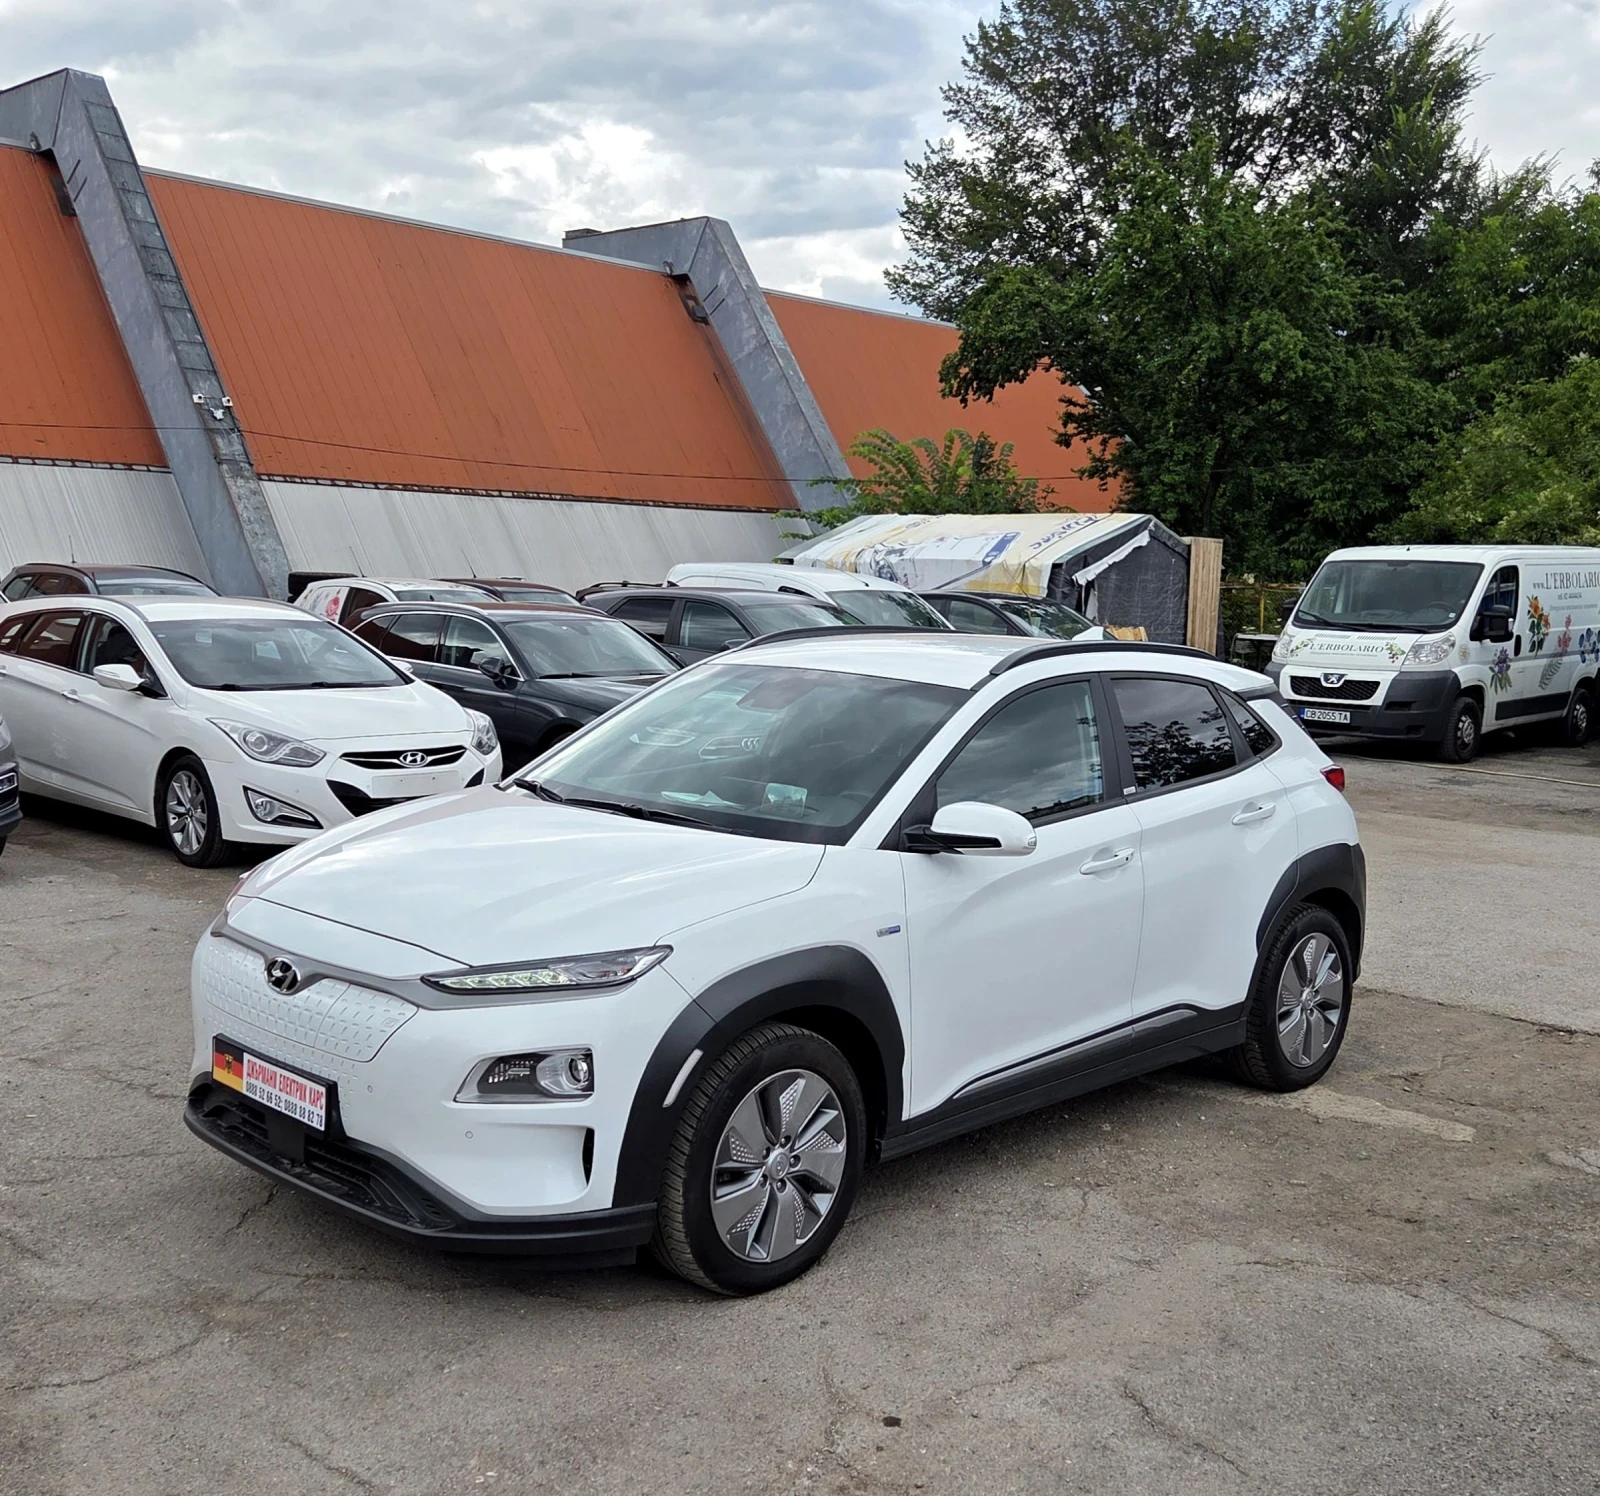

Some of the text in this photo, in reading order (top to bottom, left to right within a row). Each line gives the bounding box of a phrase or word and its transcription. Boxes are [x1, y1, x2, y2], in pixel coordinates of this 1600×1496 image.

[1310, 643, 1384, 653] L'ERBOLARIO
[1317, 710, 1336, 721] 2055
[1338, 712, 1348, 721] TA
[259, 1086, 265, 1101] 52
[279, 1073, 307, 1103] ЕЛЕКТРИК
[308, 1086, 324, 1111] КАРС
